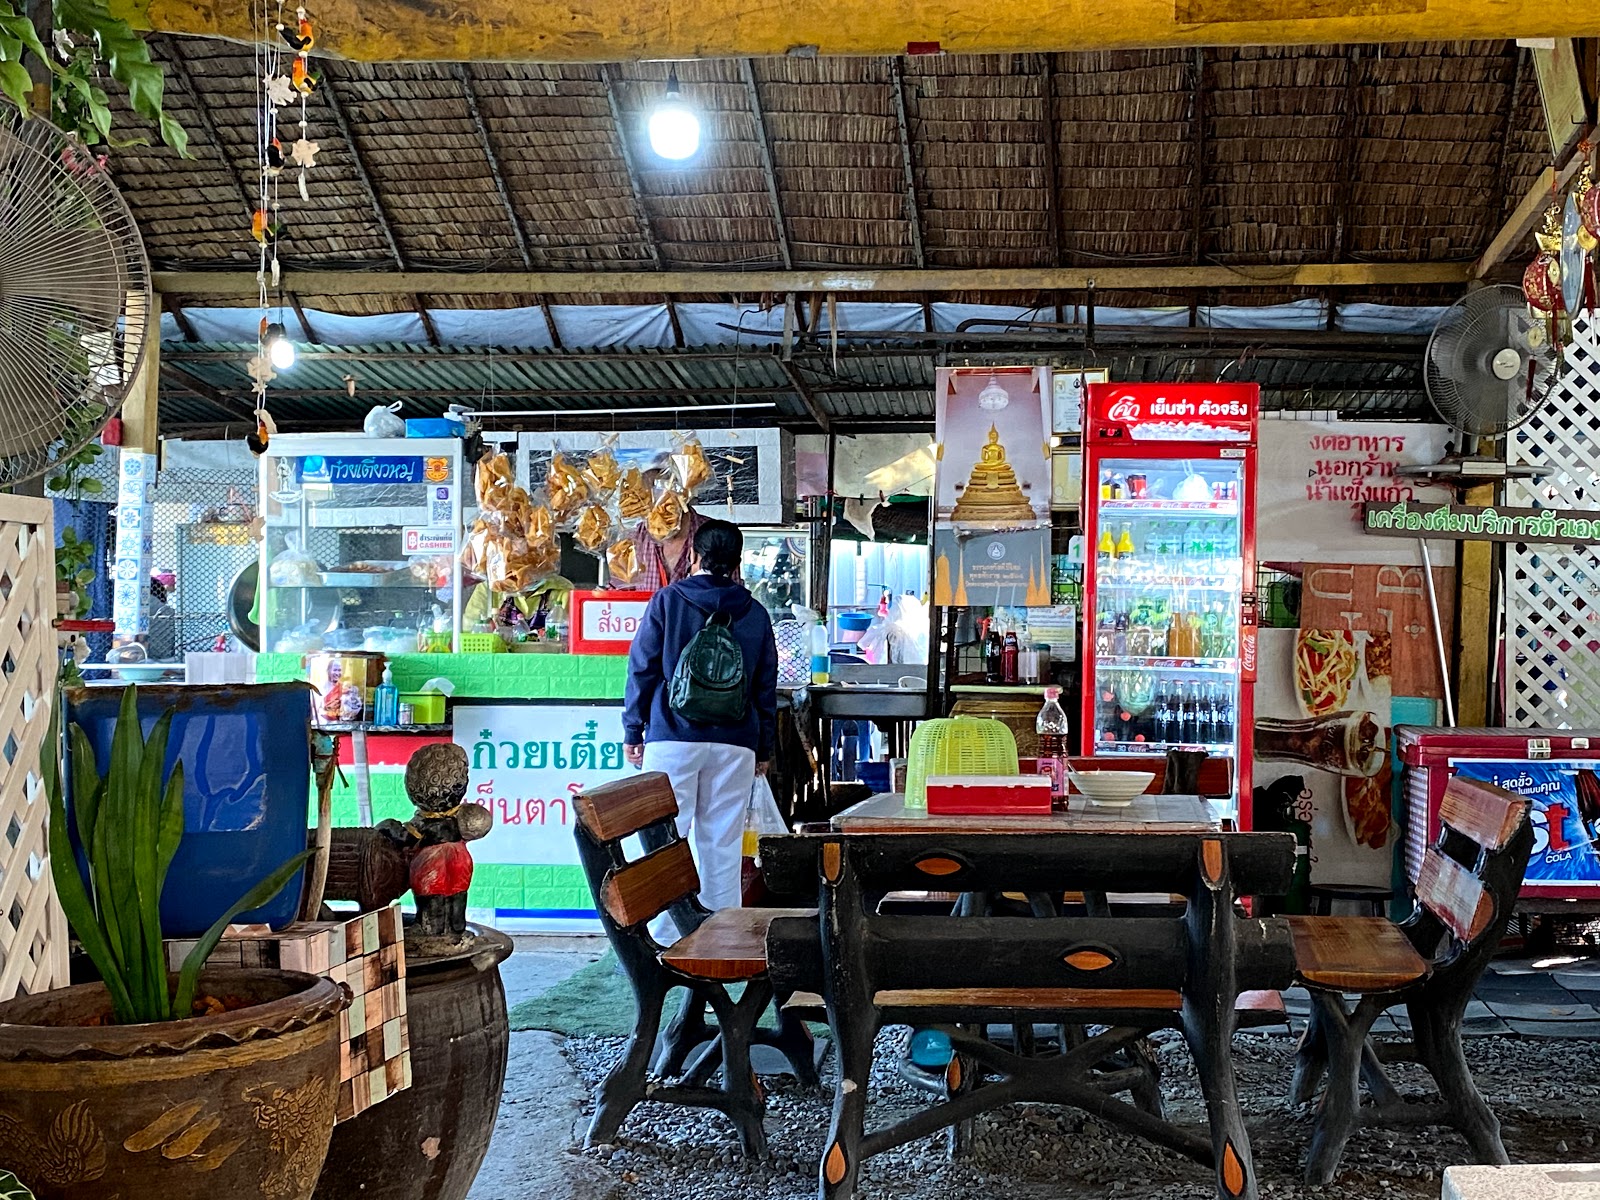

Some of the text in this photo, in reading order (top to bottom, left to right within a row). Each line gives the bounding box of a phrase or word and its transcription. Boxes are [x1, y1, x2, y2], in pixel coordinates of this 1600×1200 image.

[1150, 398, 1248, 416] เย็นซ่า ตัวจริง
[1309, 435, 1406, 452] งดอาหาร
[598, 602, 643, 633] สั่งอ
[472, 719, 640, 770] ก๋วยเตี๋ย
[1545, 852, 1572, 864] COLA
